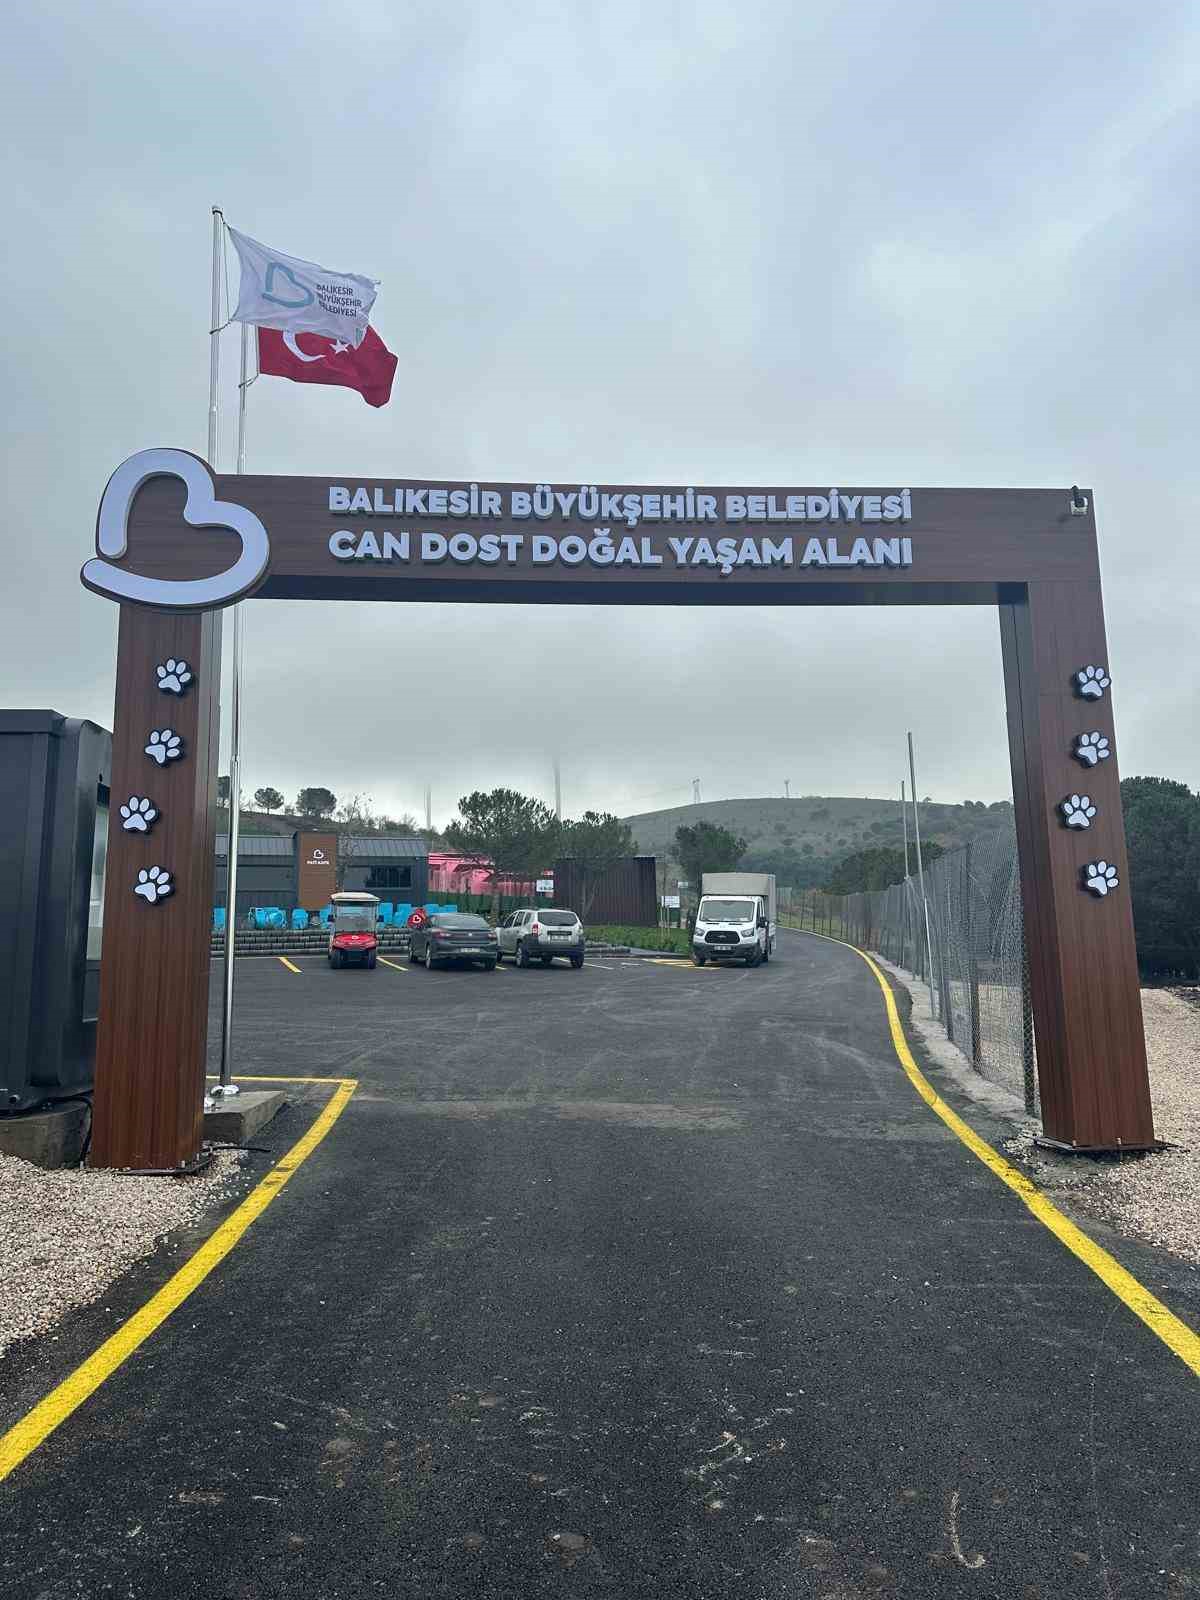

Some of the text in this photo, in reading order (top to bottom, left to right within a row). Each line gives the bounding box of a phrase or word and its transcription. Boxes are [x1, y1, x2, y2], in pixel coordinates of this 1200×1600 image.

[329, 484, 912, 526] BALIKESİR BÜYÜKŞEHİR BELEDİYESİ
[328, 528, 913, 574] CAN DOST DOĞAL YAŞAM ALANI
